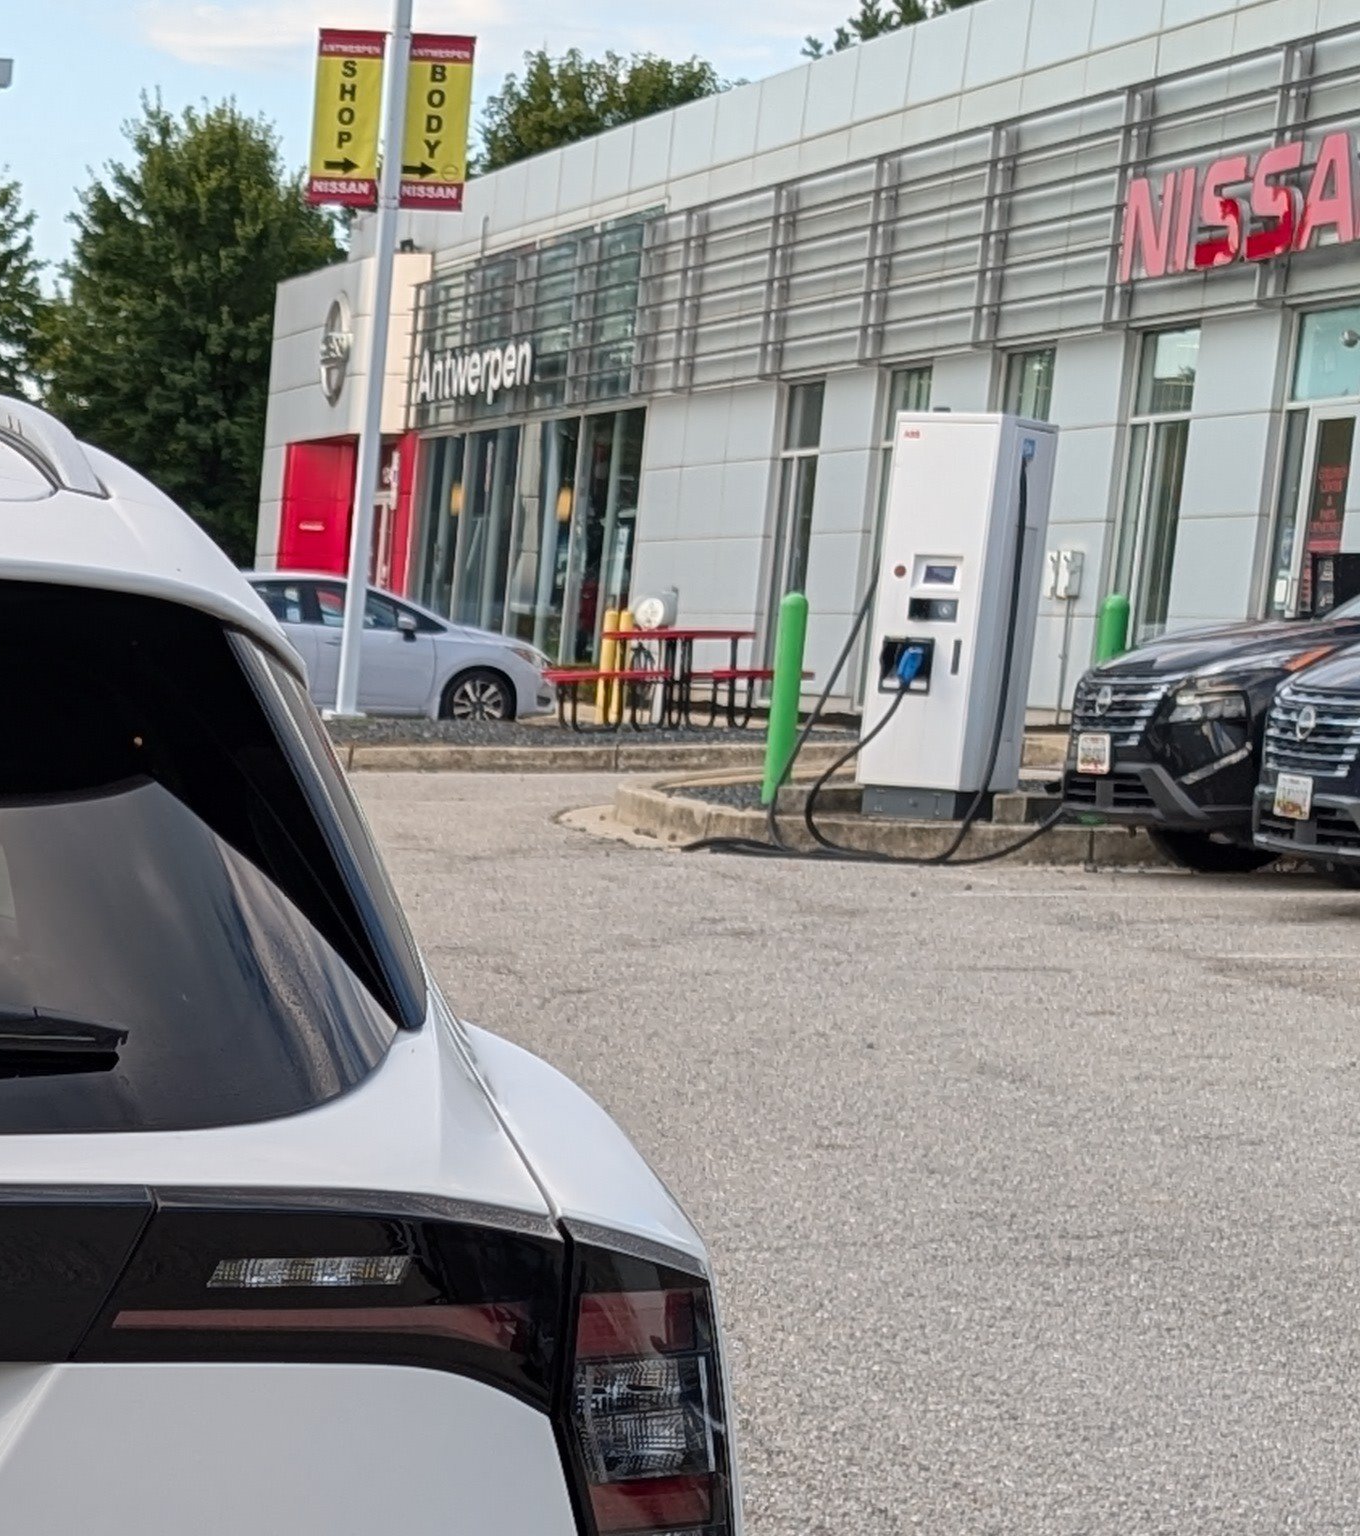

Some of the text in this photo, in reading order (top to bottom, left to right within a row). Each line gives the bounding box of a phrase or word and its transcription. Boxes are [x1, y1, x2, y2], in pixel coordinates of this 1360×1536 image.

[336, 60, 358, 149] SHOP
[424, 64, 447, 159] BODY
[312, 180, 370, 195] NISSAN
[401, 183, 458, 199] NISSAN
[1117, 130, 1360, 284] NISSA
[416, 340, 532, 405] Antwerpen
